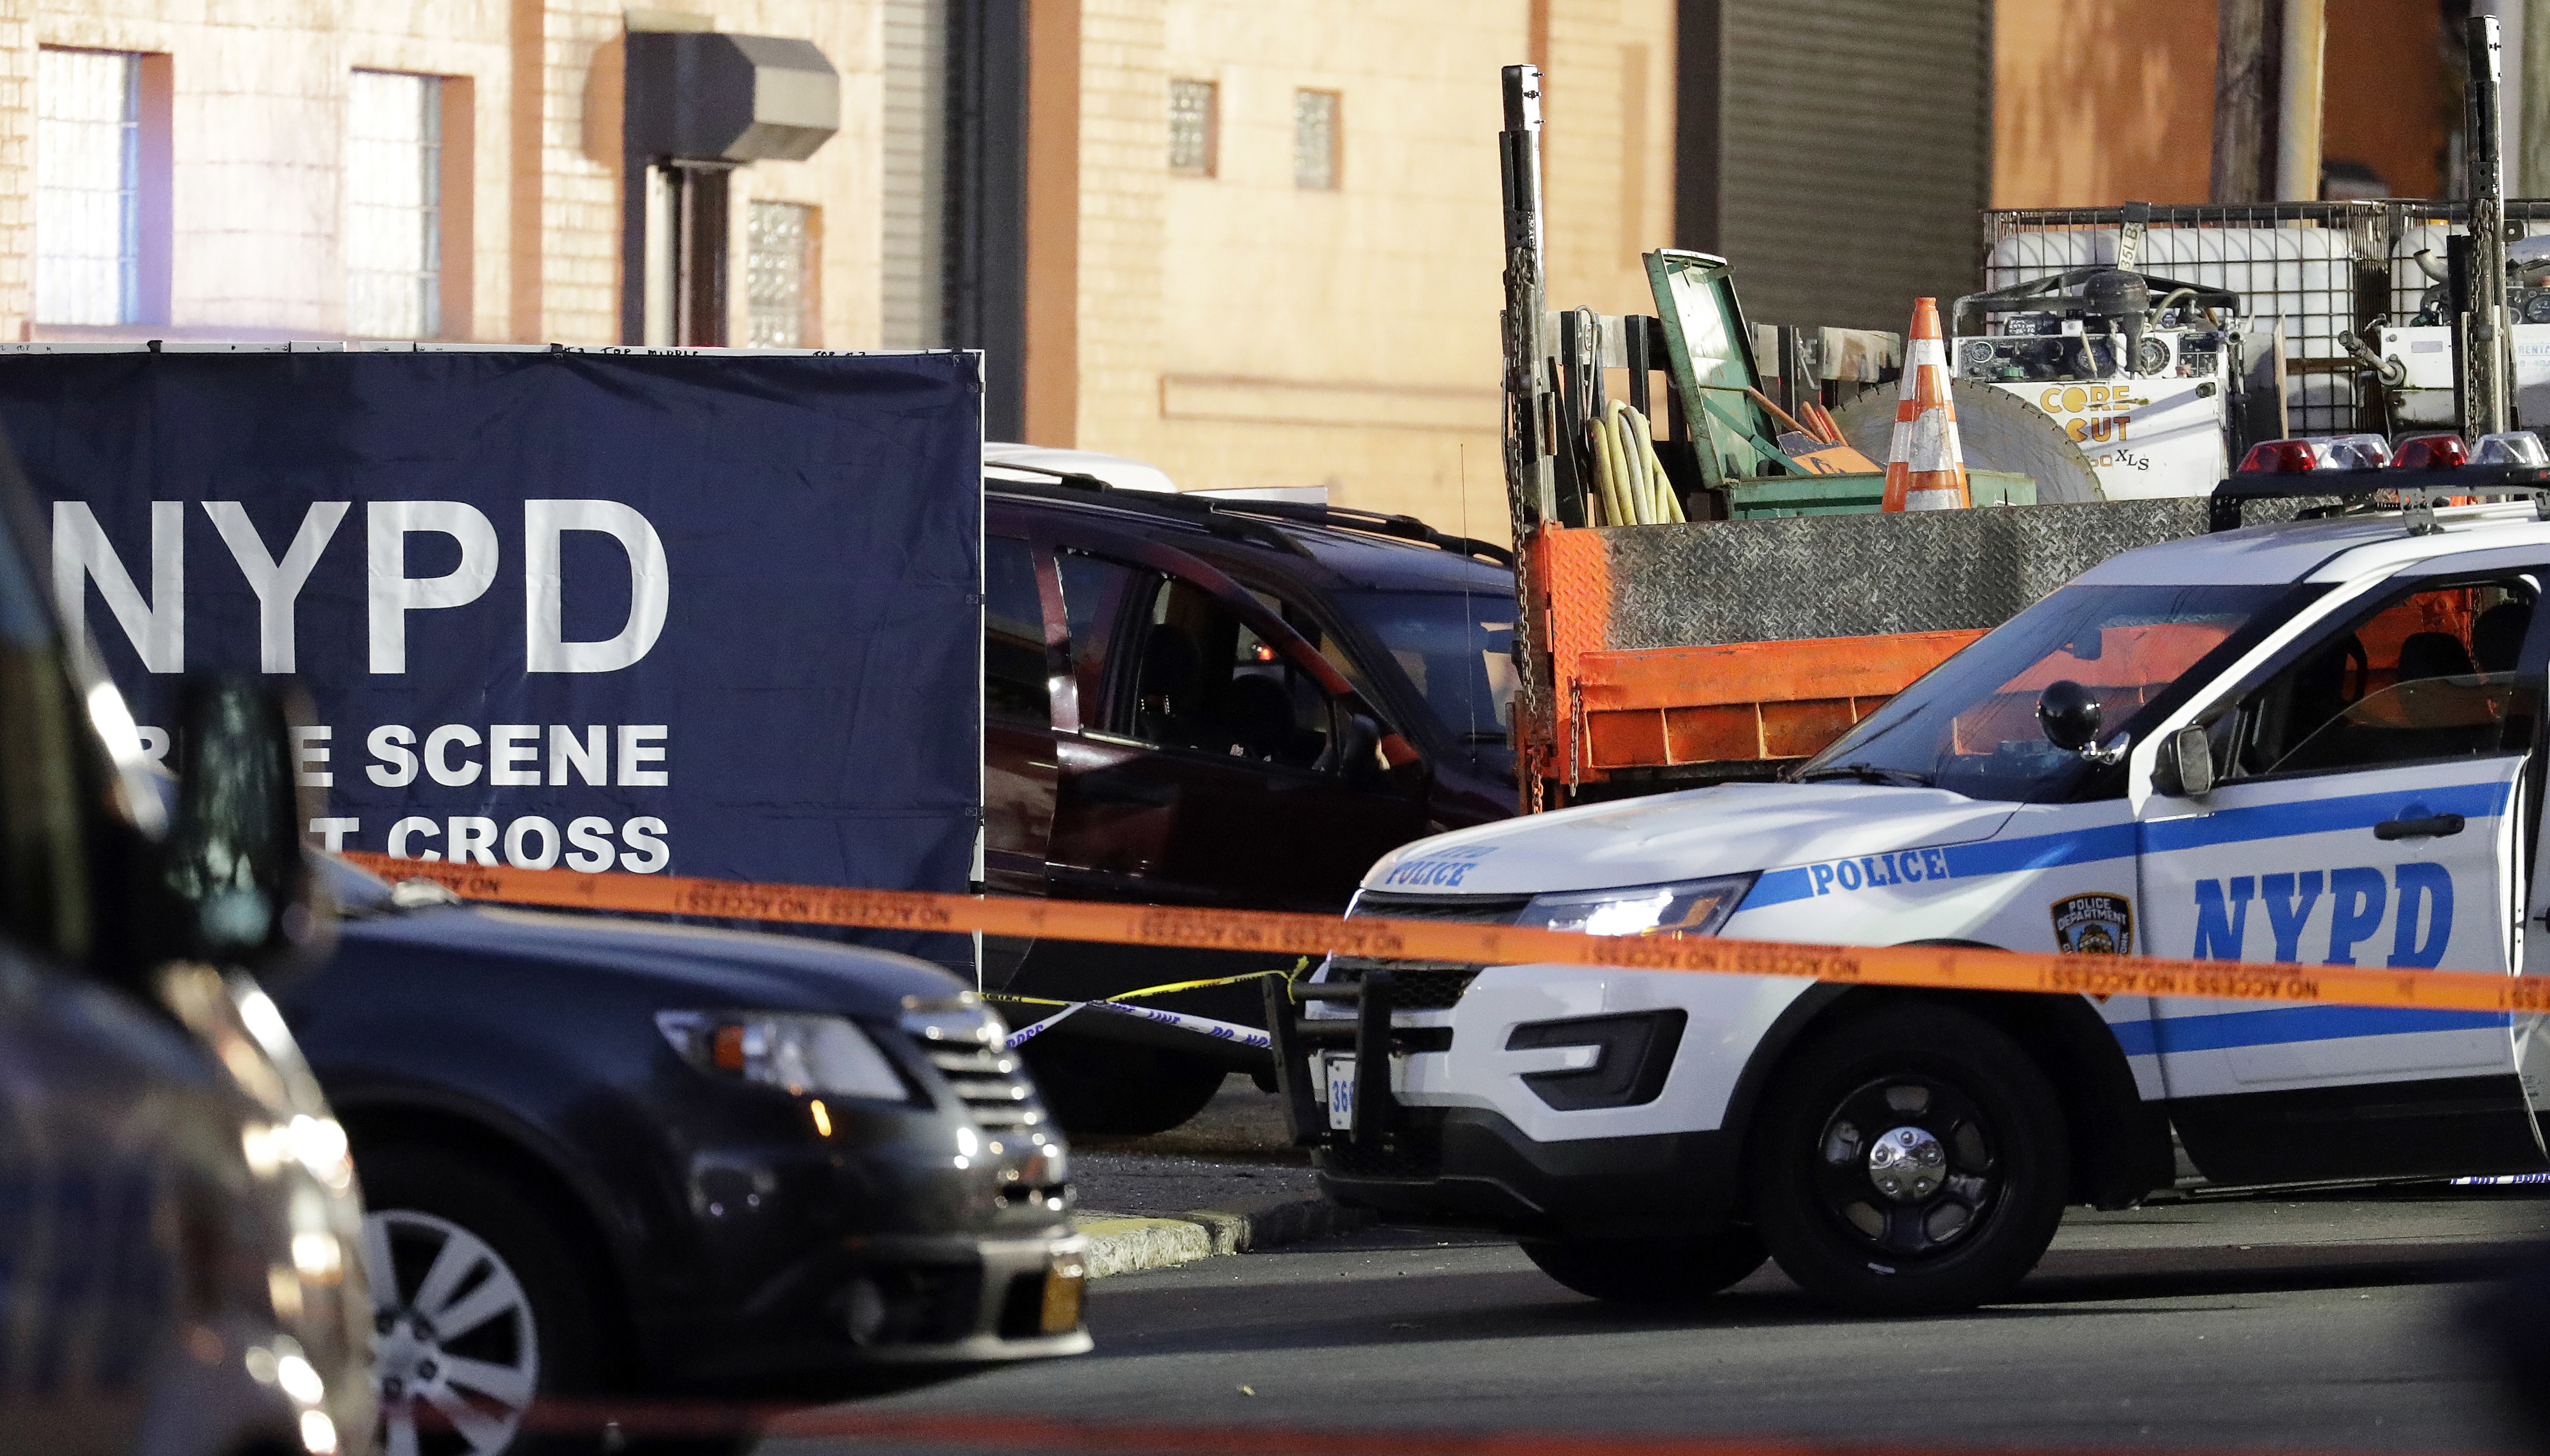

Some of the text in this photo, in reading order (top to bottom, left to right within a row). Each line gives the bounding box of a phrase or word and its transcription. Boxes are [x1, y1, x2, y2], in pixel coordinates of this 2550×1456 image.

[2040, 386, 2130, 413] CORE
[2065, 416, 2131, 443] CUT
[53, 500, 669, 674] NYPD
[366, 724, 668, 787] SCENE
[388, 816, 670, 873] CROSS
[1385, 861, 1478, 887] POLICE
[1810, 848, 1947, 891] POLICE
[2057, 908, 2127, 931] DEPARTMENT
[2068, 897, 2112, 913] POLICE
[2194, 862, 2454, 970] NYPD
